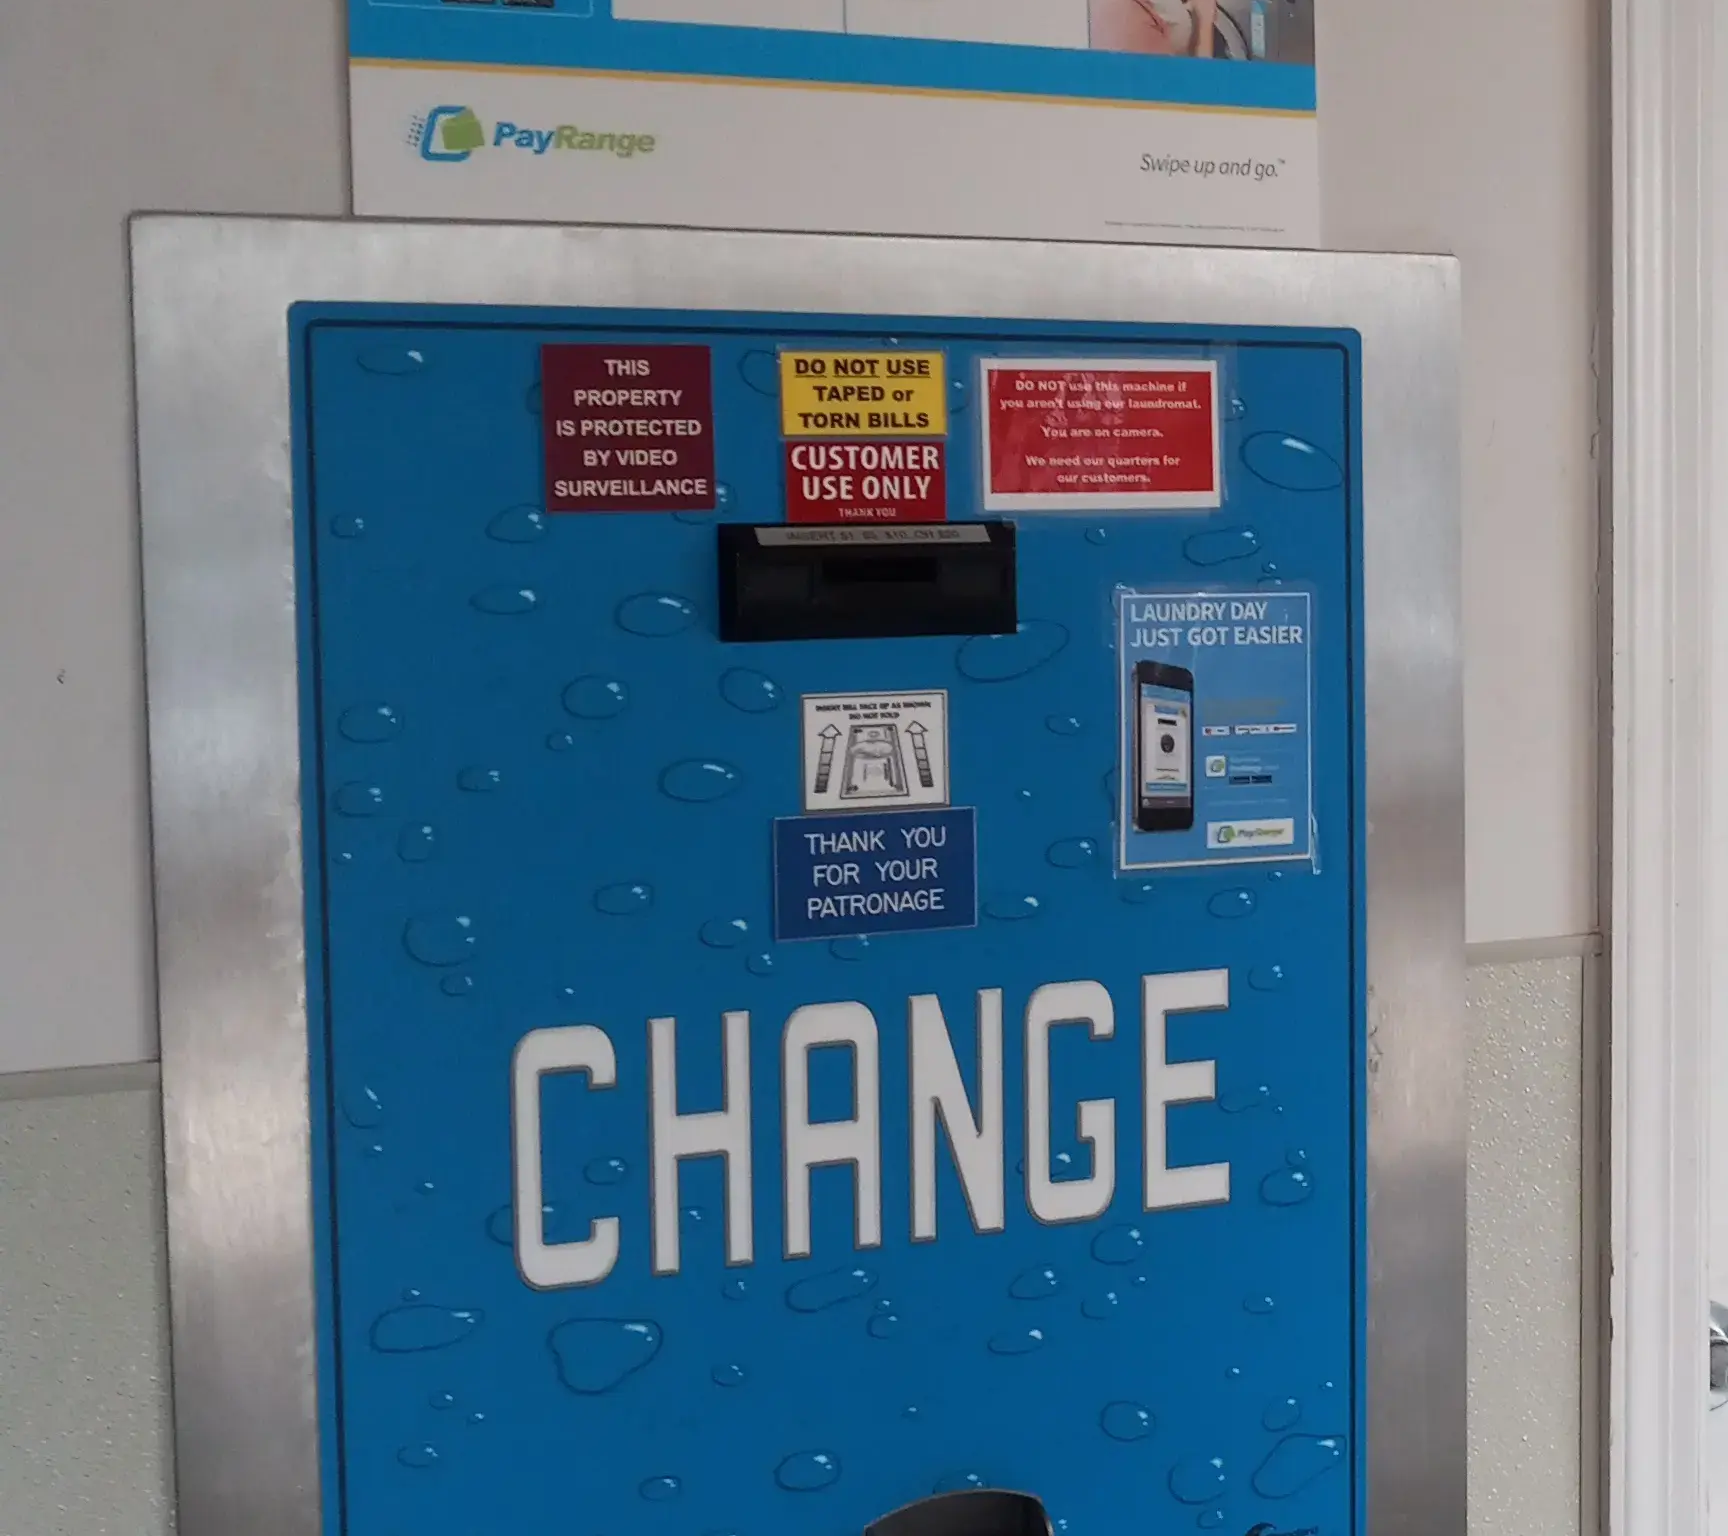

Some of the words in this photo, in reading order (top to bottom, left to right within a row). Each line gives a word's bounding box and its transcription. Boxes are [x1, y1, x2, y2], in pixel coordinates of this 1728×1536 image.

[493, 121, 655, 158] PayRange
[1140, 153, 1190, 177] Swipe
[1194, 158, 1215, 178] up
[1219, 158, 1251, 177] and
[603, 359, 650, 377] THIS
[794, 358, 827, 375] DO
[833, 359, 879, 375] NOT
[886, 359, 930, 376] USE
[812, 385, 885, 402] TAPED
[892, 389, 914, 402] or
[1015, 380, 1035, 392] DO
[1038, 381, 1067, 392] NOT
[1095, 381, 1119, 392] this
[1123, 381, 1175, 392] machine
[573, 389, 683, 407] PROPERTY
[1000, 399, 1024, 411] you
[1128, 398, 1202, 410] laundromat.
[556, 420, 576, 436] IS
[580, 420, 701, 437] PROTECTED
[798, 412, 861, 429] TORN
[868, 412, 930, 428] BILLS
[1040, 425, 1067, 438] You
[1070, 428, 1092, 438] are
[1113, 427, 1164, 438] camera.
[583, 449, 610, 466] BY
[617, 449, 678, 466] VIDEO
[791, 445, 939, 471] CUSTOMER
[1083, 457, 1104, 466] our
[1108, 456, 1160, 469] quarters
[1163, 454, 1181, 466] for
[1057, 474, 1078, 483] our
[1081, 473, 1152, 484] customers.
[554, 479, 707, 497] SURVEILLANCE
[802, 475, 853, 501] USE
[862, 475, 931, 501] ONLY
[838, 507, 874, 518] THANK
[877, 507, 896, 517] YOU
[1130, 602, 1224, 622] LAUNDRY
[1230, 601, 1268, 621] DAY
[1130, 628, 1182, 648] JUST
[1187, 627, 1229, 647] GOT
[1234, 625, 1303, 645] EASIER
[804, 829, 886, 856] THANK
[900, 826, 947, 849] YOU
[812, 863, 860, 888] FOR
[875, 858, 938, 883] YOUR
[807, 888, 945, 920] PATRONAGE
[509, 967, 1232, 1292] CHANGE
